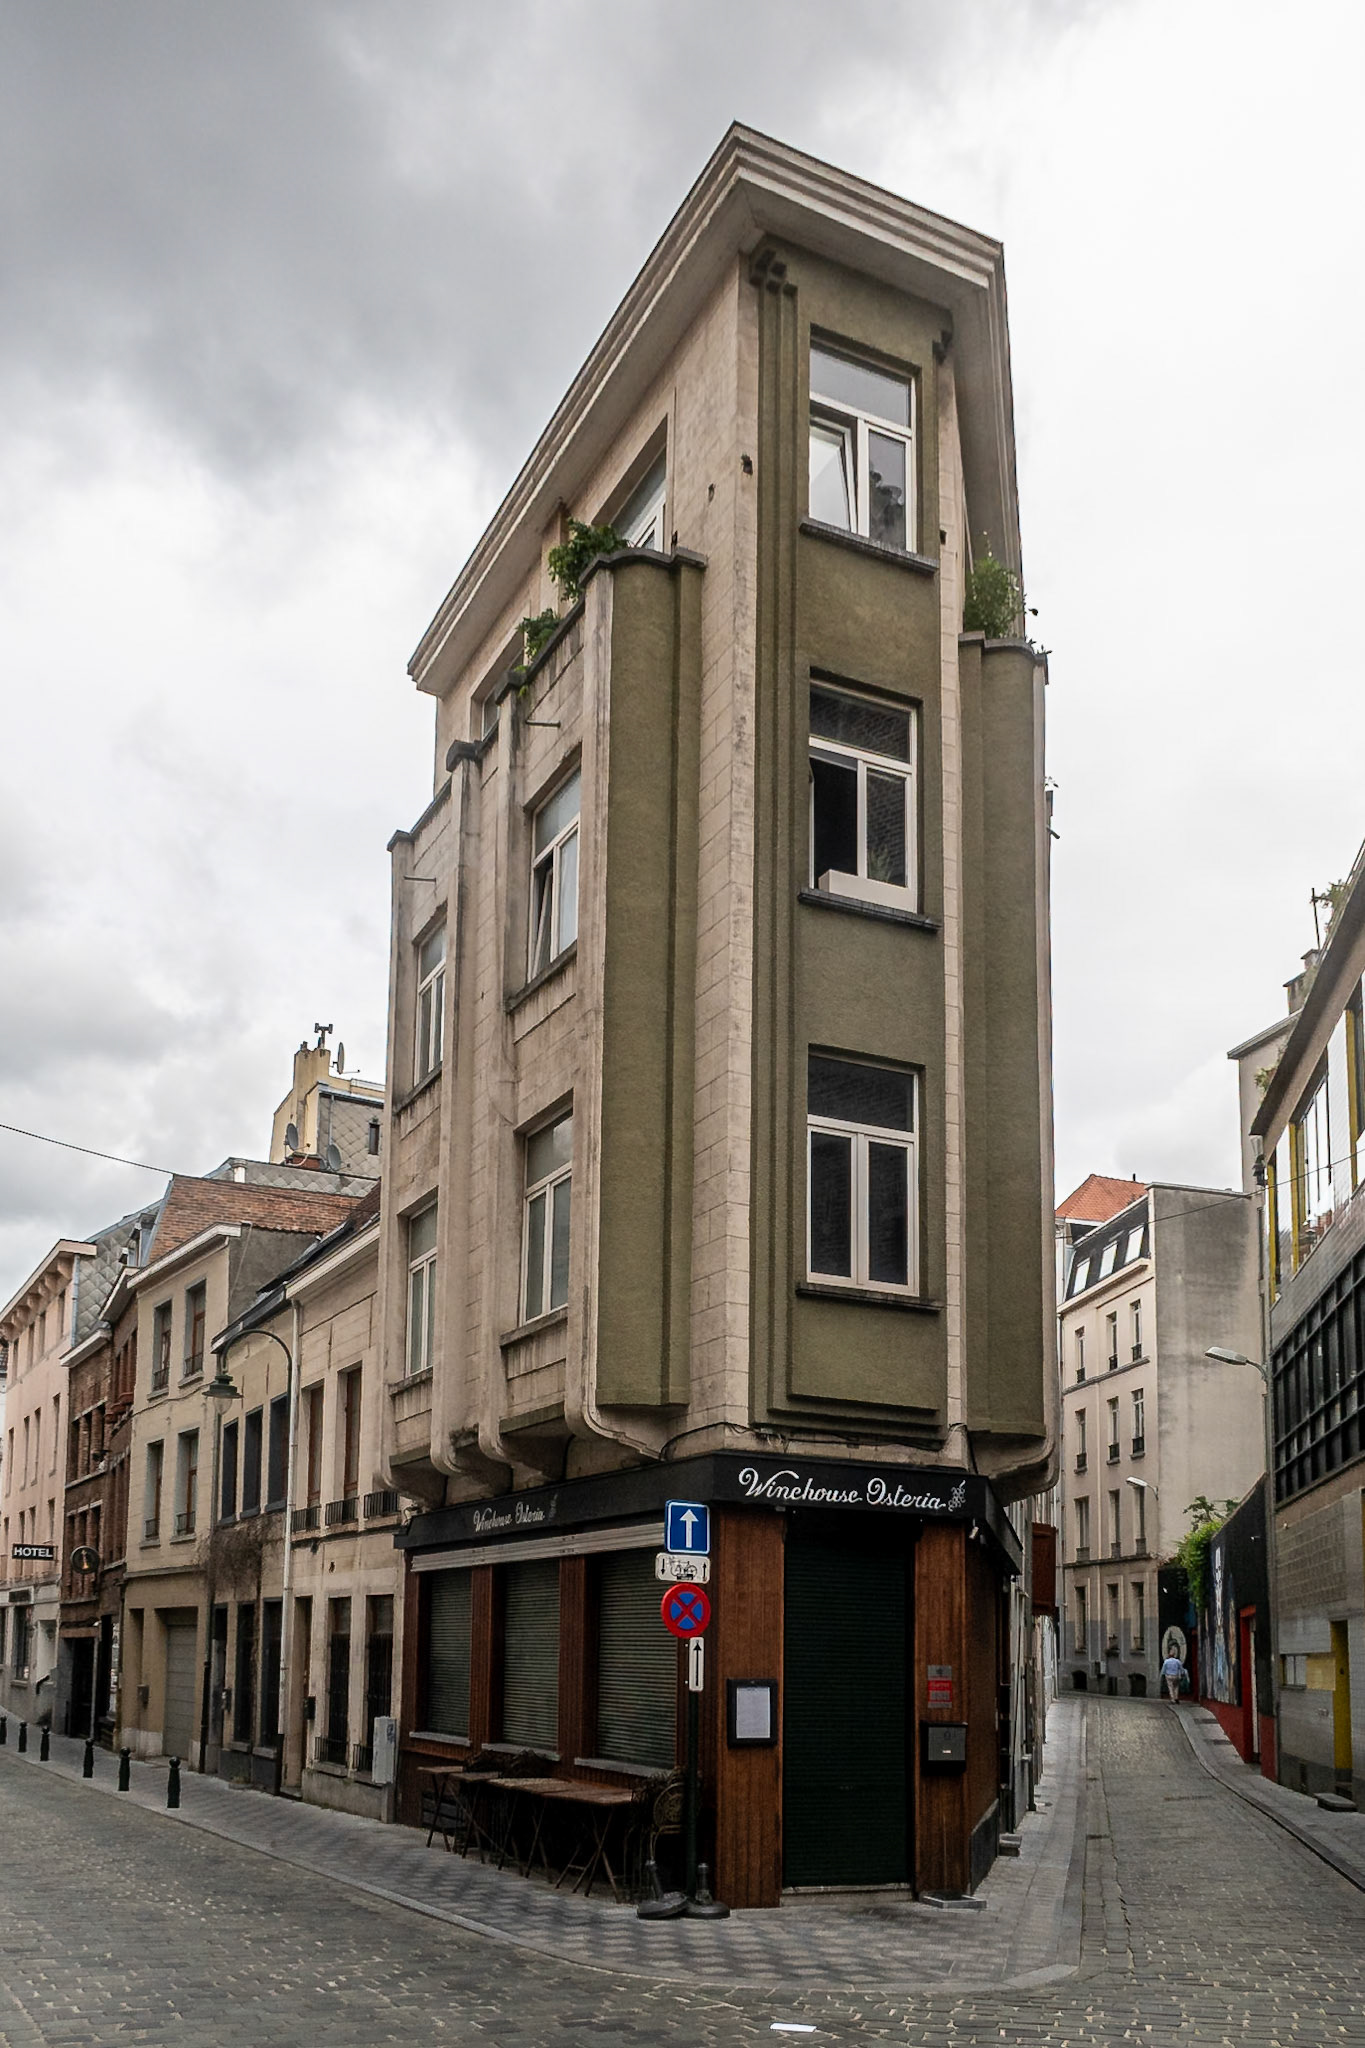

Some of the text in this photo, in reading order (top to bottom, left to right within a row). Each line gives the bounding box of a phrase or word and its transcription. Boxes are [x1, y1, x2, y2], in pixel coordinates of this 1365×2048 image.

[738, 1467, 947, 1509] Winehouse Osteria
[515, 1501, 546, 1524] Osteria
[14, 1547, 53, 1557] HOTEL
